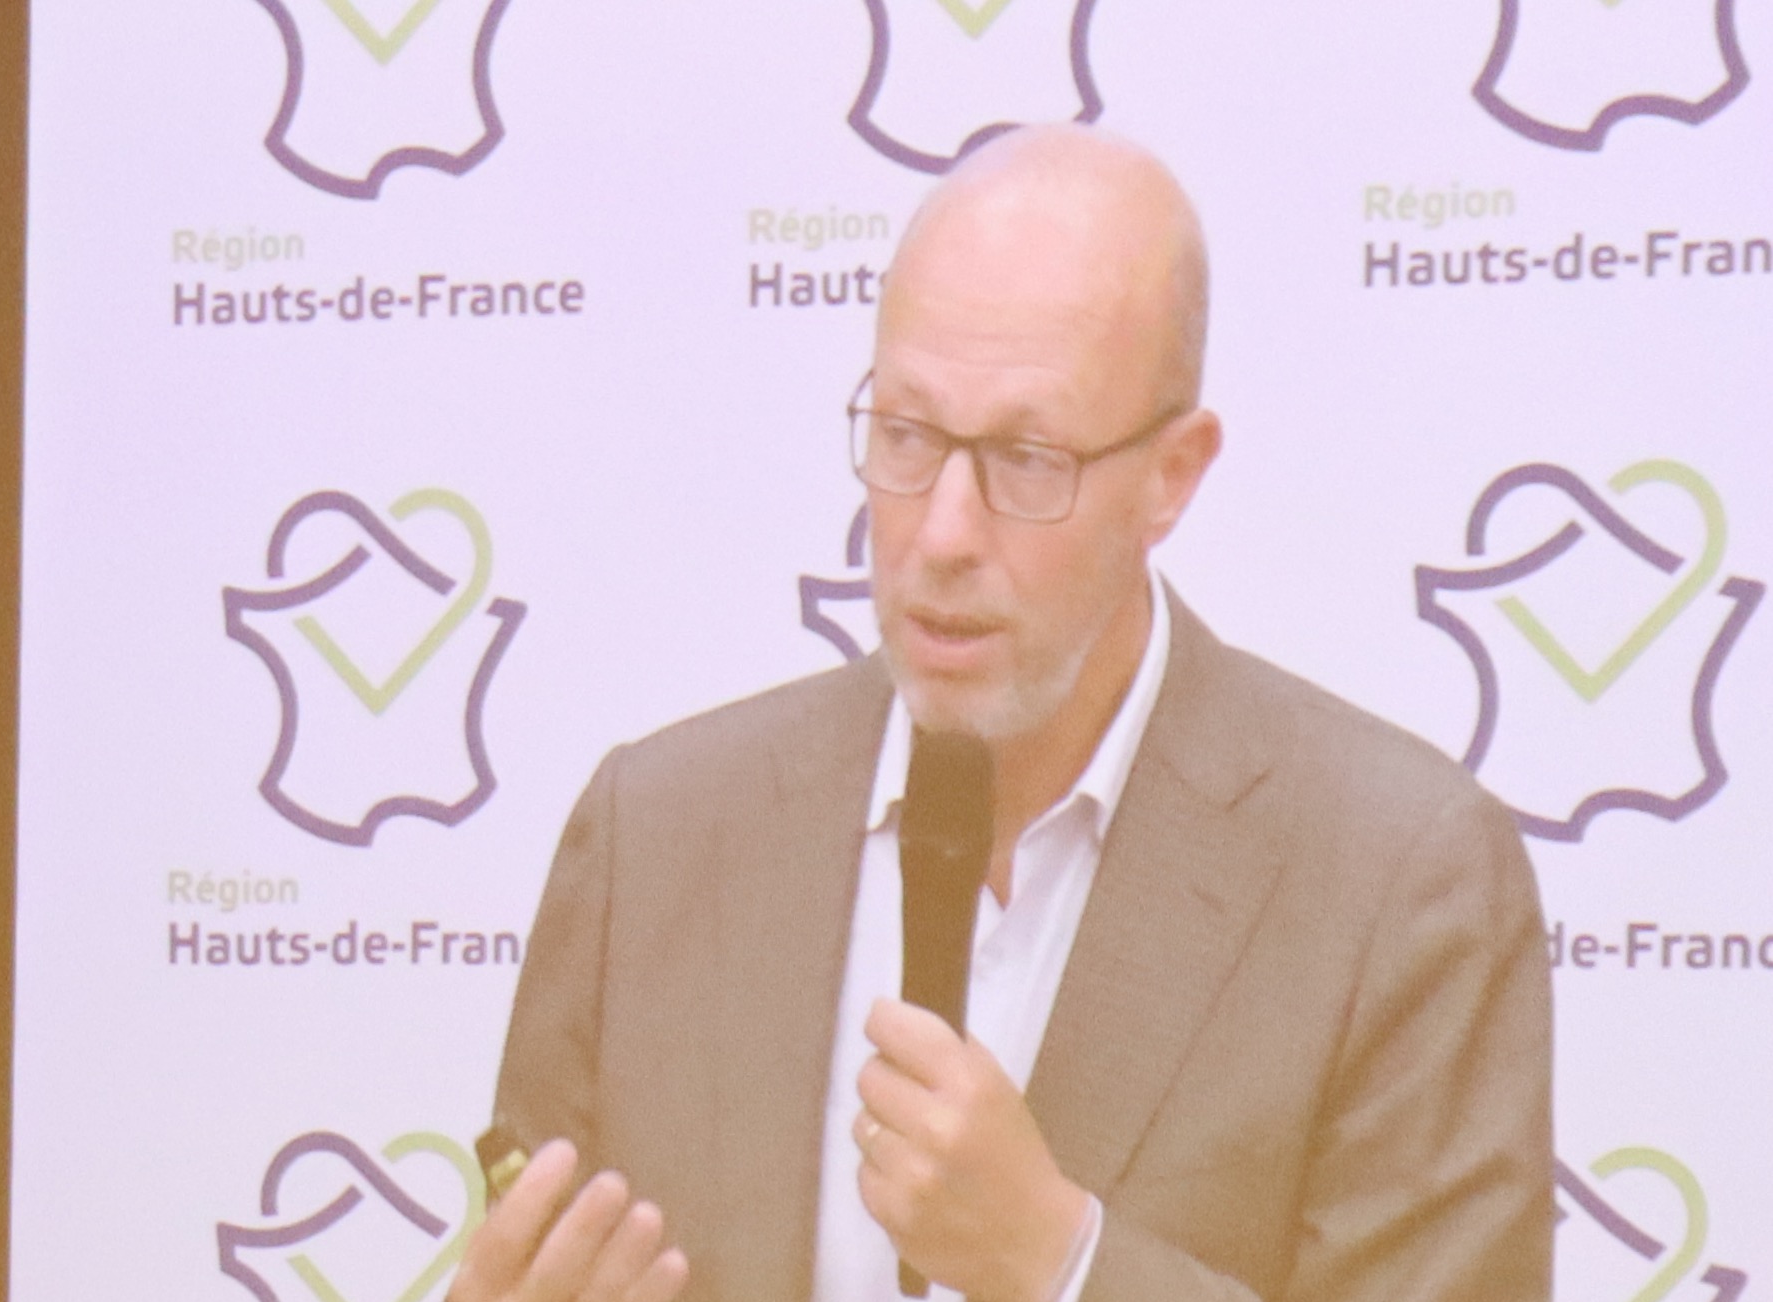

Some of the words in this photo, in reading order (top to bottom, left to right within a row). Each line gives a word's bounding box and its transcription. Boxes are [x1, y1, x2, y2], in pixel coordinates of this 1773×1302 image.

[1363, 182, 1516, 229] Région
[171, 229, 305, 269] Région
[747, 206, 890, 251] Région
[1364, 231, 1772, 287] Hauts-de-Fran
[173, 274, 586, 325] Hauts-de-France
[167, 870, 300, 912] Région
[168, 920, 520, 965] Hauts-de-Fran
